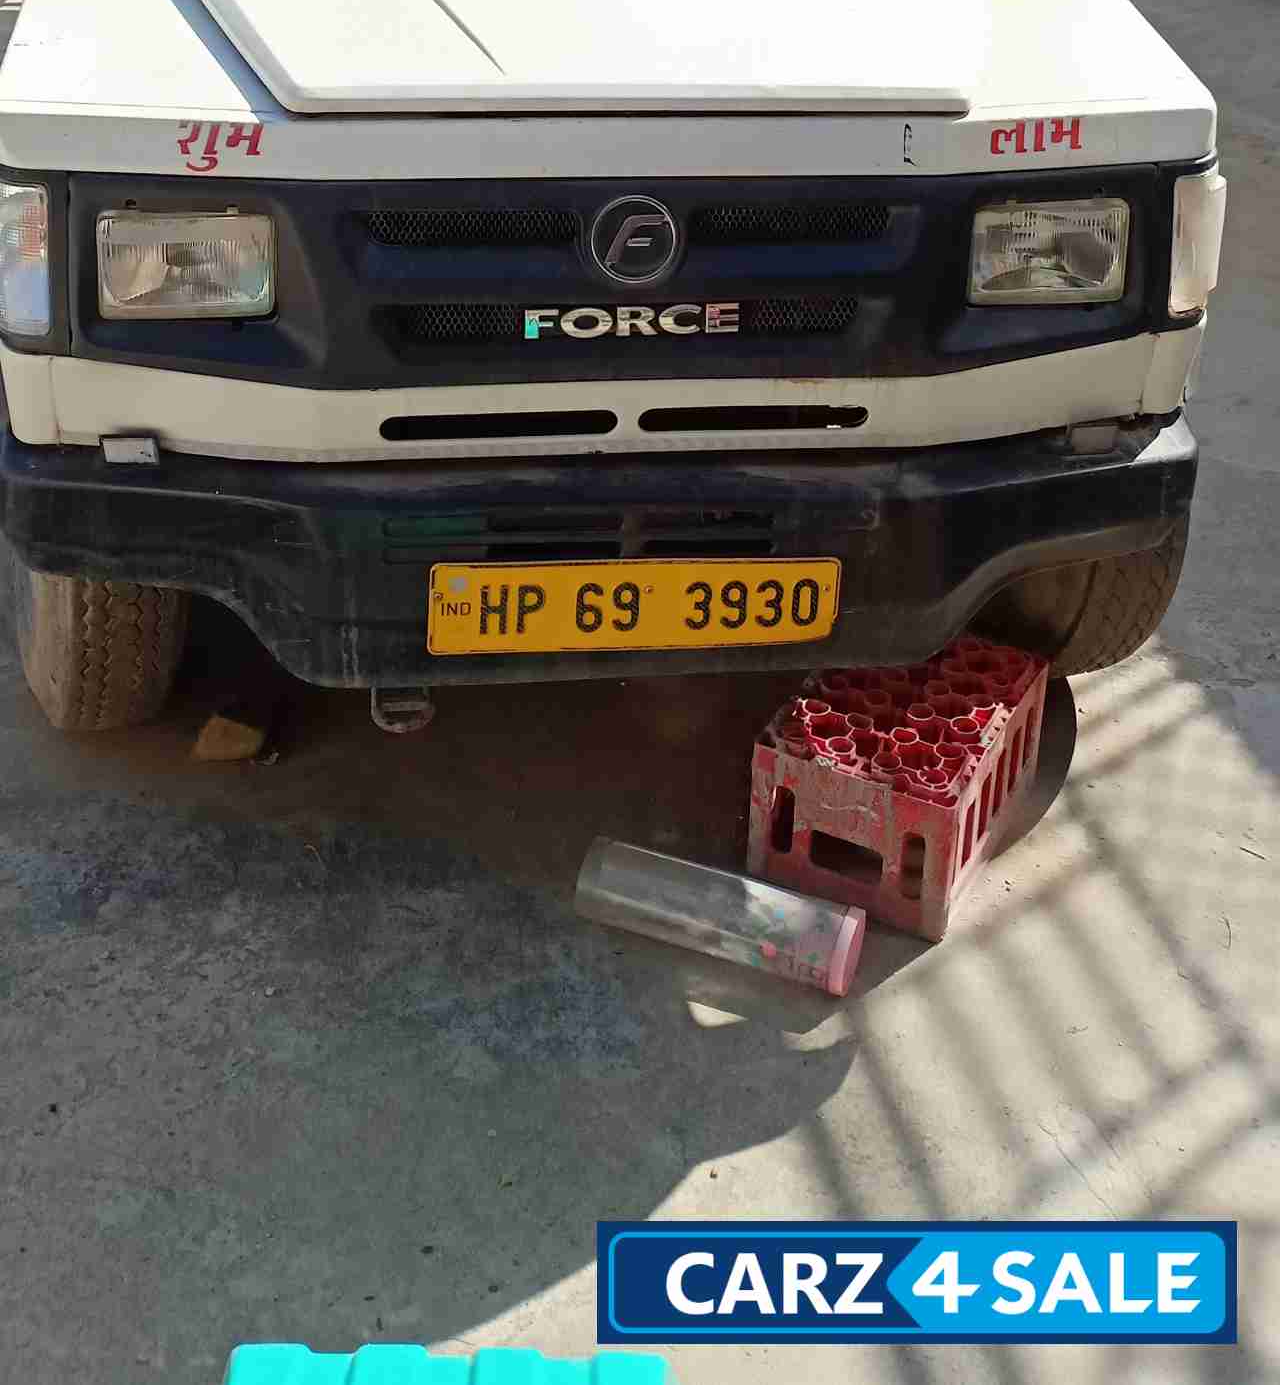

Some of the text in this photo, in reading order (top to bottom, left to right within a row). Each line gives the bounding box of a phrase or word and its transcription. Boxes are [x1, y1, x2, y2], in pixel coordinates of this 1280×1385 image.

[524, 302, 740, 339] FORCE
[440, 578, 820, 635] IND HP 69 3930
